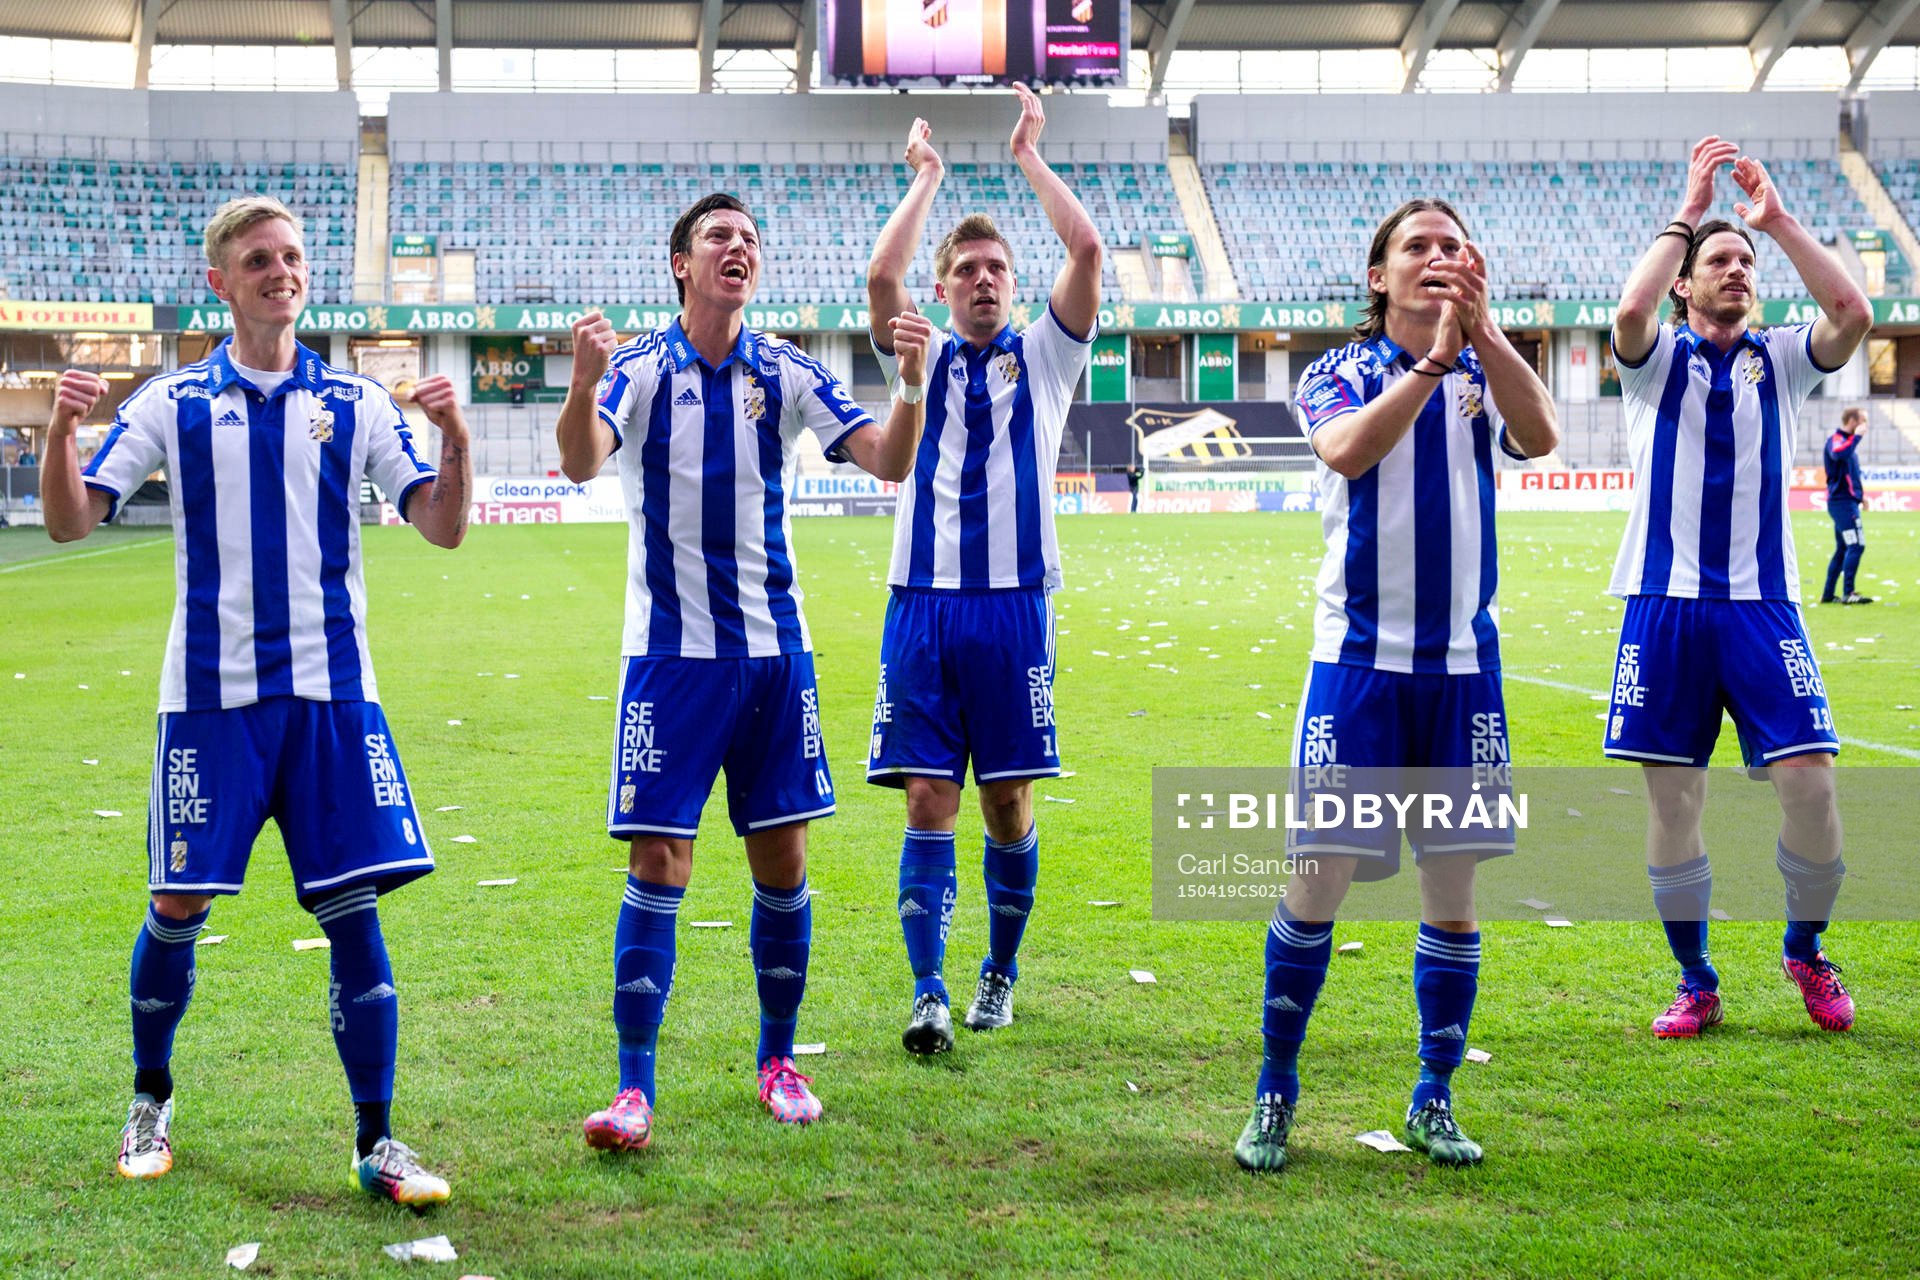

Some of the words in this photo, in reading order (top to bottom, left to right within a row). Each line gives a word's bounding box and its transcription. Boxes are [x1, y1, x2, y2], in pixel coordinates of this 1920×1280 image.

[15, 310, 145, 324] FOTBOLL
[187, 309, 235, 329] ÅBR
[299, 309, 366, 329] ÅBRO
[408, 309, 474, 329] ÅBRO
[624, 309, 677, 329] ÅBR
[1156, 307, 1220, 328] ÅBRO
[1259, 306, 1324, 327] ÅBRO
[1488, 306, 1534, 325] BRO
[1575, 304, 1616, 325] ÅBR
[494, 482, 541, 498] clean
[544, 482, 587, 501] park
[804, 479, 878, 494] FRIGGA
[484, 503, 558, 524] Finans
[1619, 643, 1641, 665] SE
[1778, 638, 1807, 659] SE
[1026, 665, 1051, 688] SE
[1617, 663, 1640, 686] RN
[1783, 658, 1815, 679] RN
[1029, 685, 1055, 708] RN
[1613, 684, 1646, 708] EKE
[1790, 677, 1826, 698] EKE
[624, 701, 654, 725] SE
[1031, 706, 1056, 729] EK
[1808, 707, 1832, 732] 13
[622, 724, 655, 749] RN
[1305, 714, 1335, 741] SE
[1471, 712, 1502, 738] SE
[365, 732, 390, 758] SE
[803, 735, 821, 760] EK
[1304, 738, 1337, 765] RN
[1471, 737, 1507, 763] RN
[168, 747, 198, 774] SE
[369, 757, 398, 783] RN
[621, 747, 664, 773] EKE
[169, 773, 200, 799] RN
[1304, 764, 1348, 790] EKE
[373, 782, 407, 807] EKE
[169, 798, 208, 824] EKE
[402, 817, 417, 846] 8
